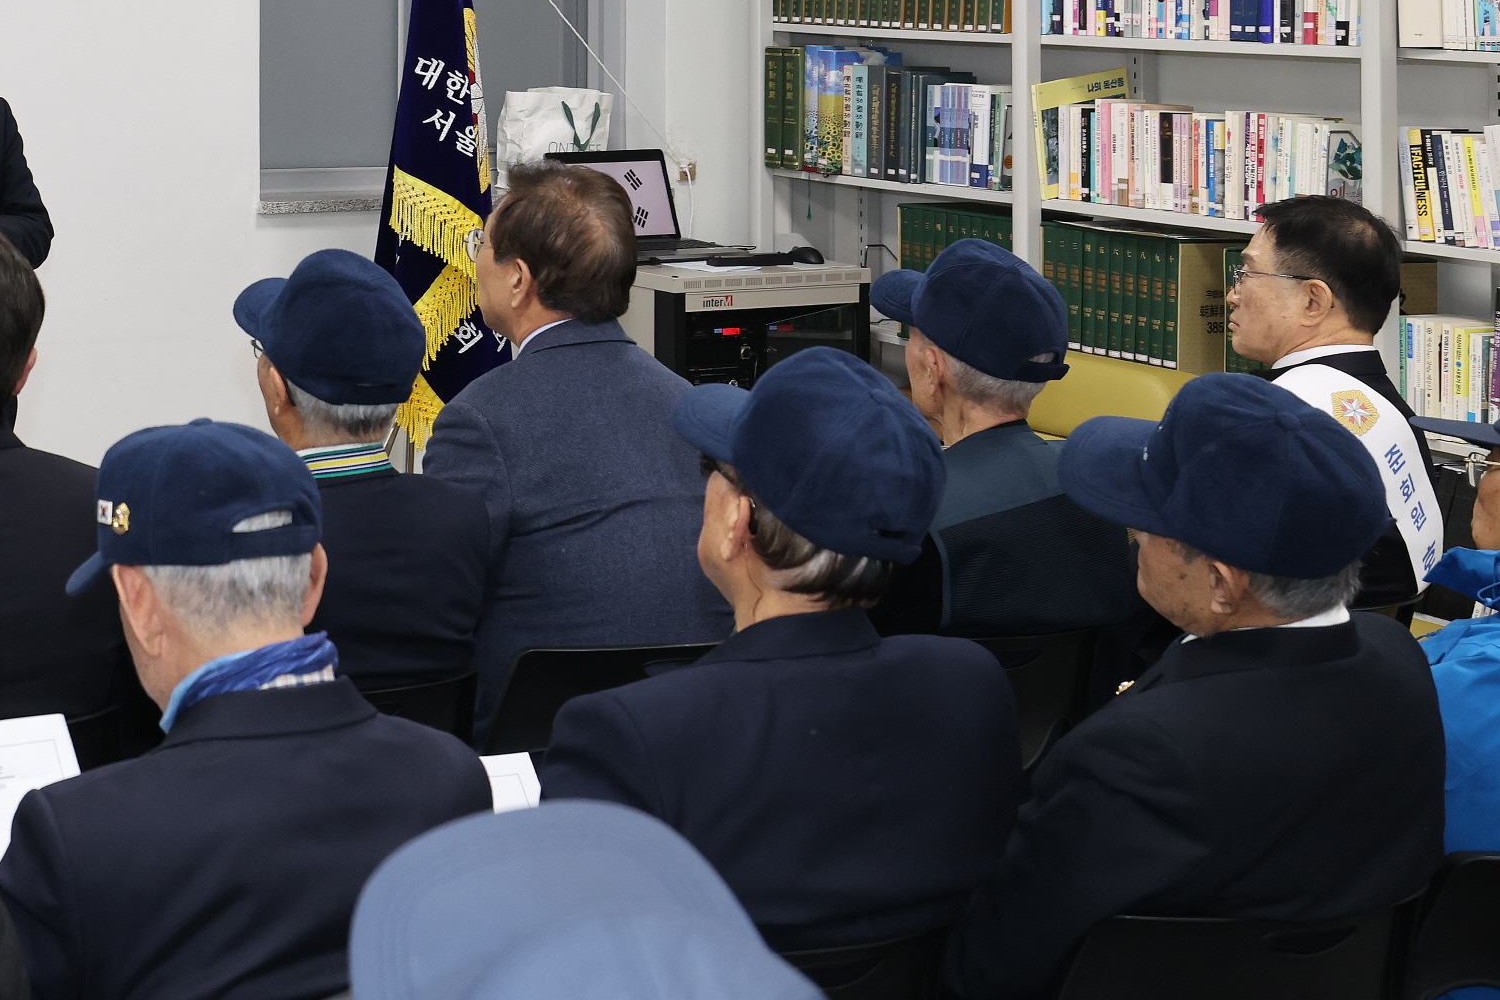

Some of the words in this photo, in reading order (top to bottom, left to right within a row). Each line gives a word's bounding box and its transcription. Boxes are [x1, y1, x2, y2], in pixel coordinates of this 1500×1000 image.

[414, 56, 471, 106] 대한
[1087, 81, 1102, 93] 나의
[422, 108, 478, 158] 서울
[1411, 150, 1428, 217] FACTFULNESS
[702, 295, 733, 308] interM
[1206, 321, 1225, 334] 385
